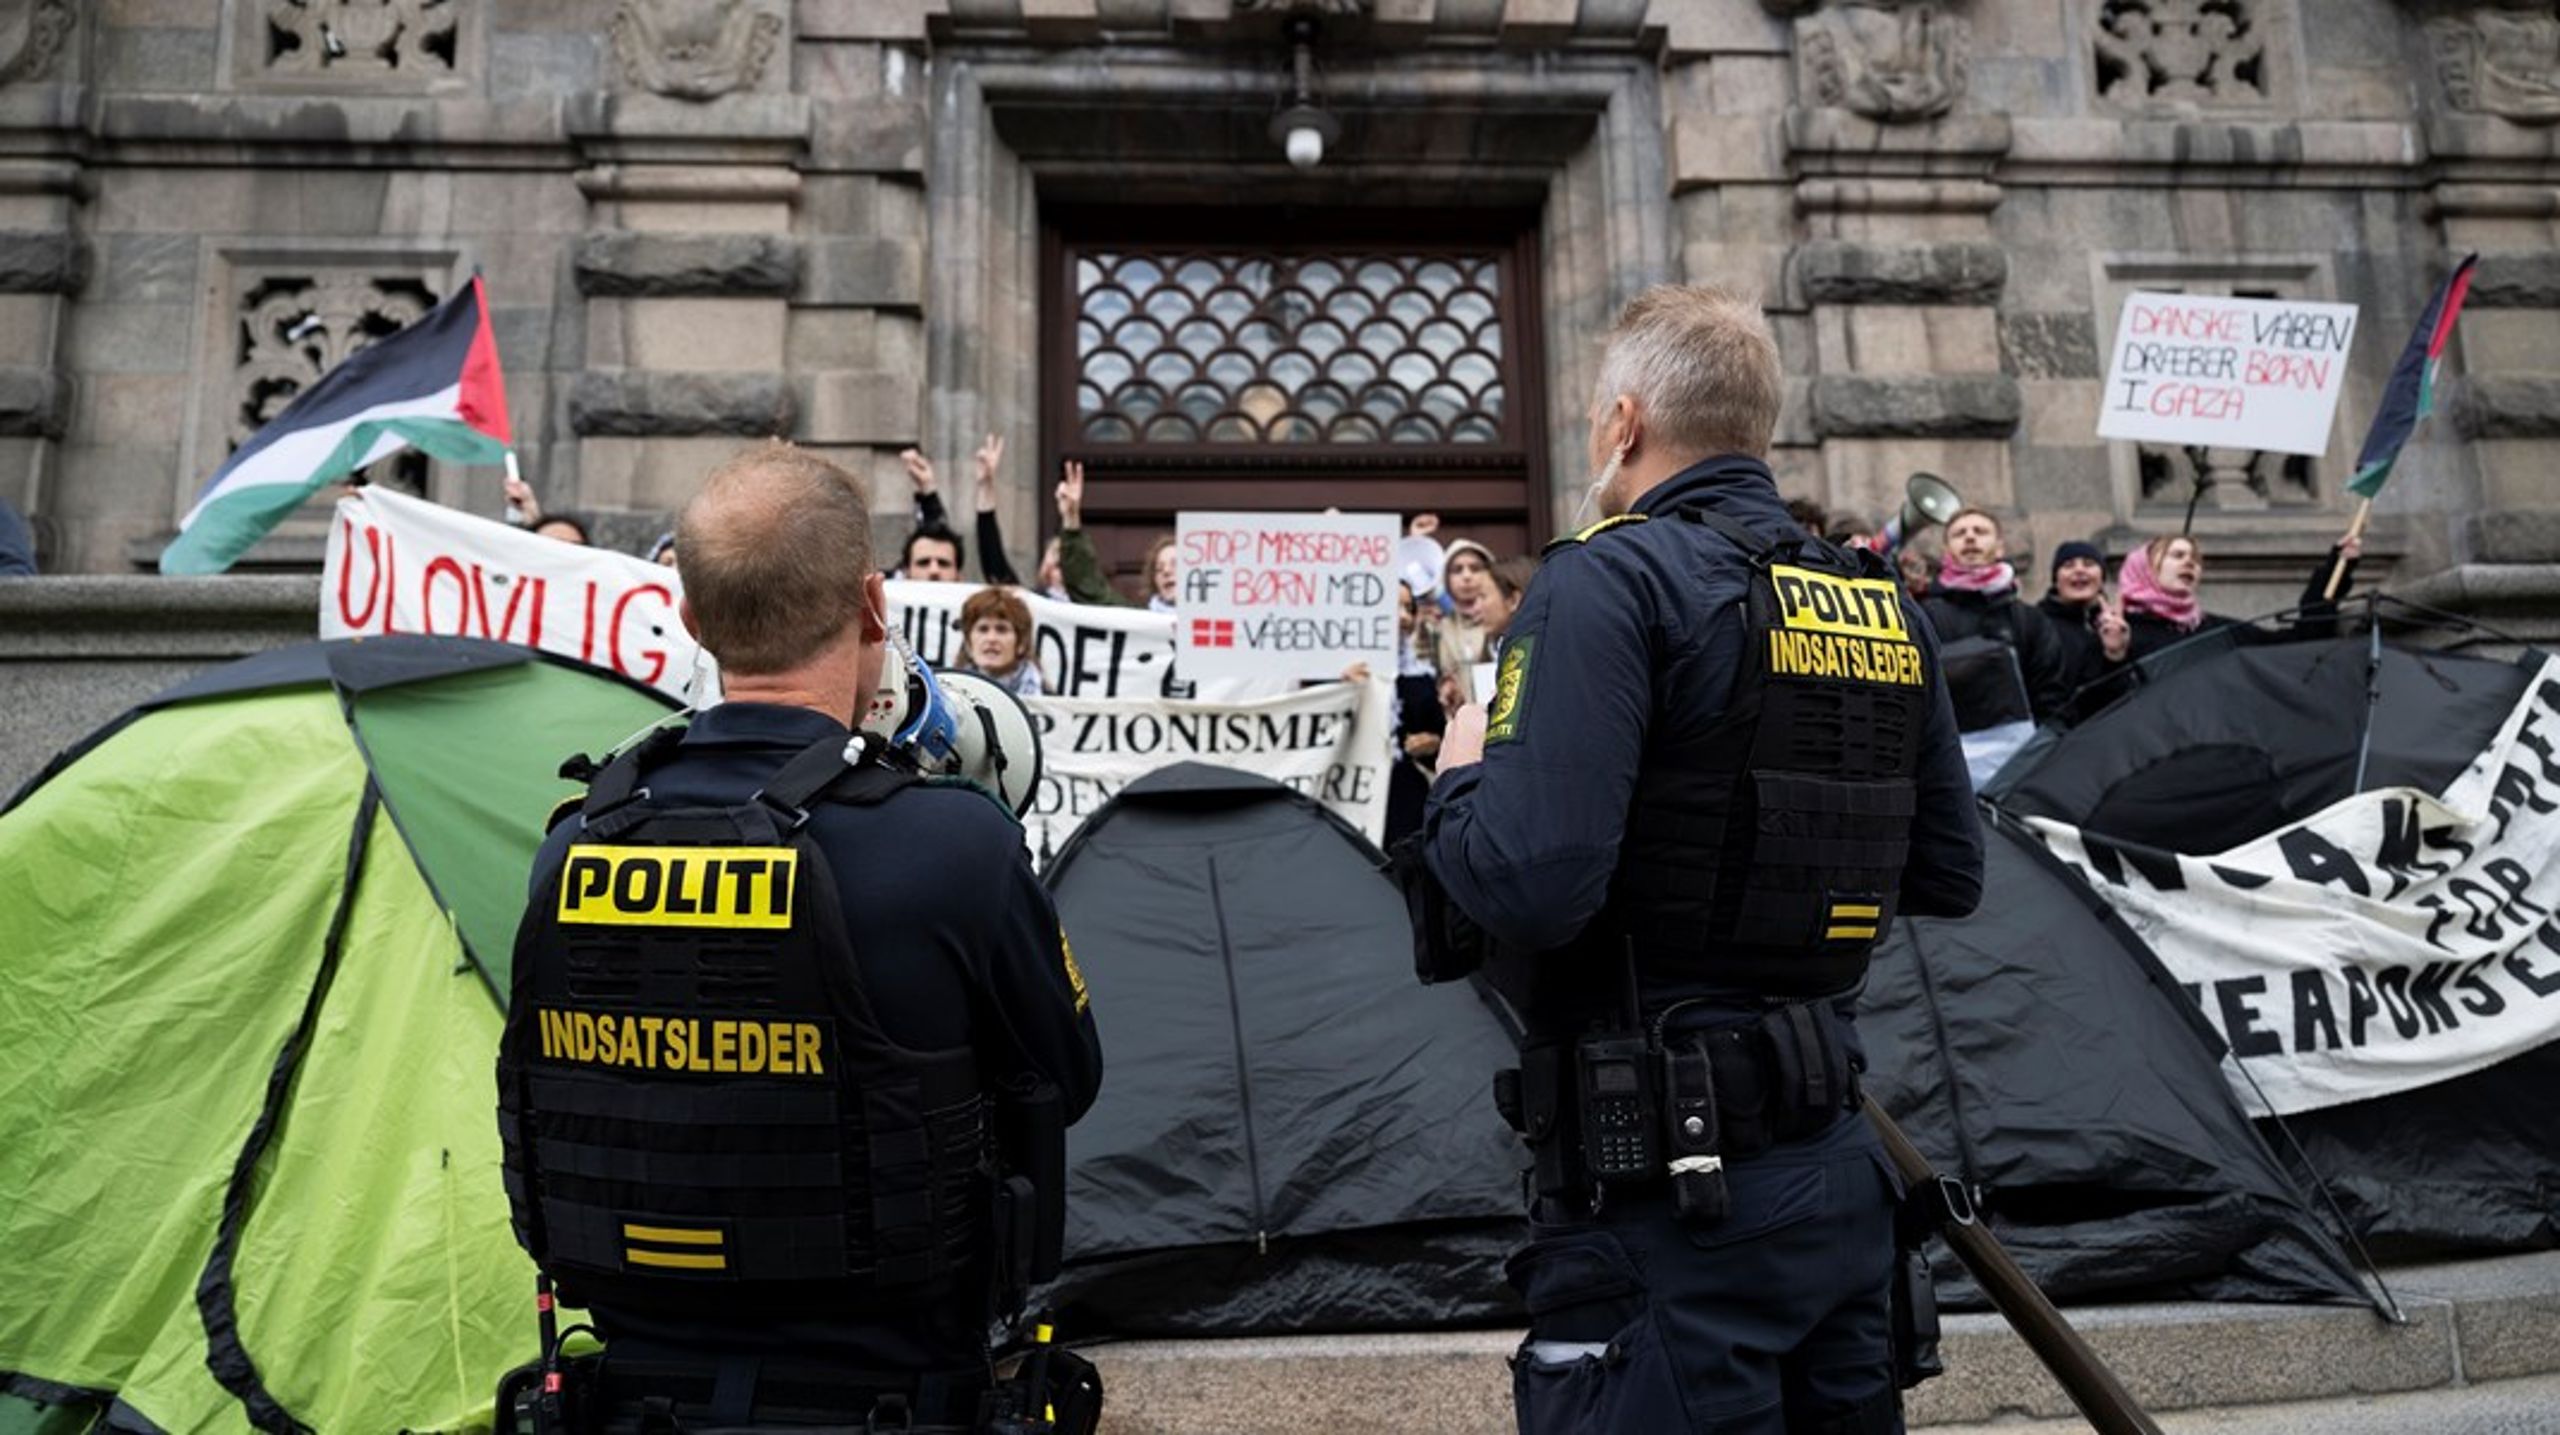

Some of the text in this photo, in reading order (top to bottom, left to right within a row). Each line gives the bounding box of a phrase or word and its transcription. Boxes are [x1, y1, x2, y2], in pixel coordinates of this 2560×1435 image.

[2130, 305, 2351, 351] DANSKE VÅBEN
[2121, 342, 2331, 391] DRÆBER BØRN
[2114, 379, 2245, 421] I GAZA
[1182, 530, 1392, 567] STOP MASSEDRAB
[338, 518, 674, 686] ULOVLIG
[1186, 568, 1385, 607] AF BØRN MED
[1776, 575, 1907, 630] POLITI
[1243, 612, 1391, 651] VÅBENDELE
[1769, 630, 1924, 686] INDSATSLEDER
[565, 856, 794, 916] POLITI
[2182, 951, 2505, 1058] EAPONS
[538, 1008, 824, 1076] INDSATSLEDER
